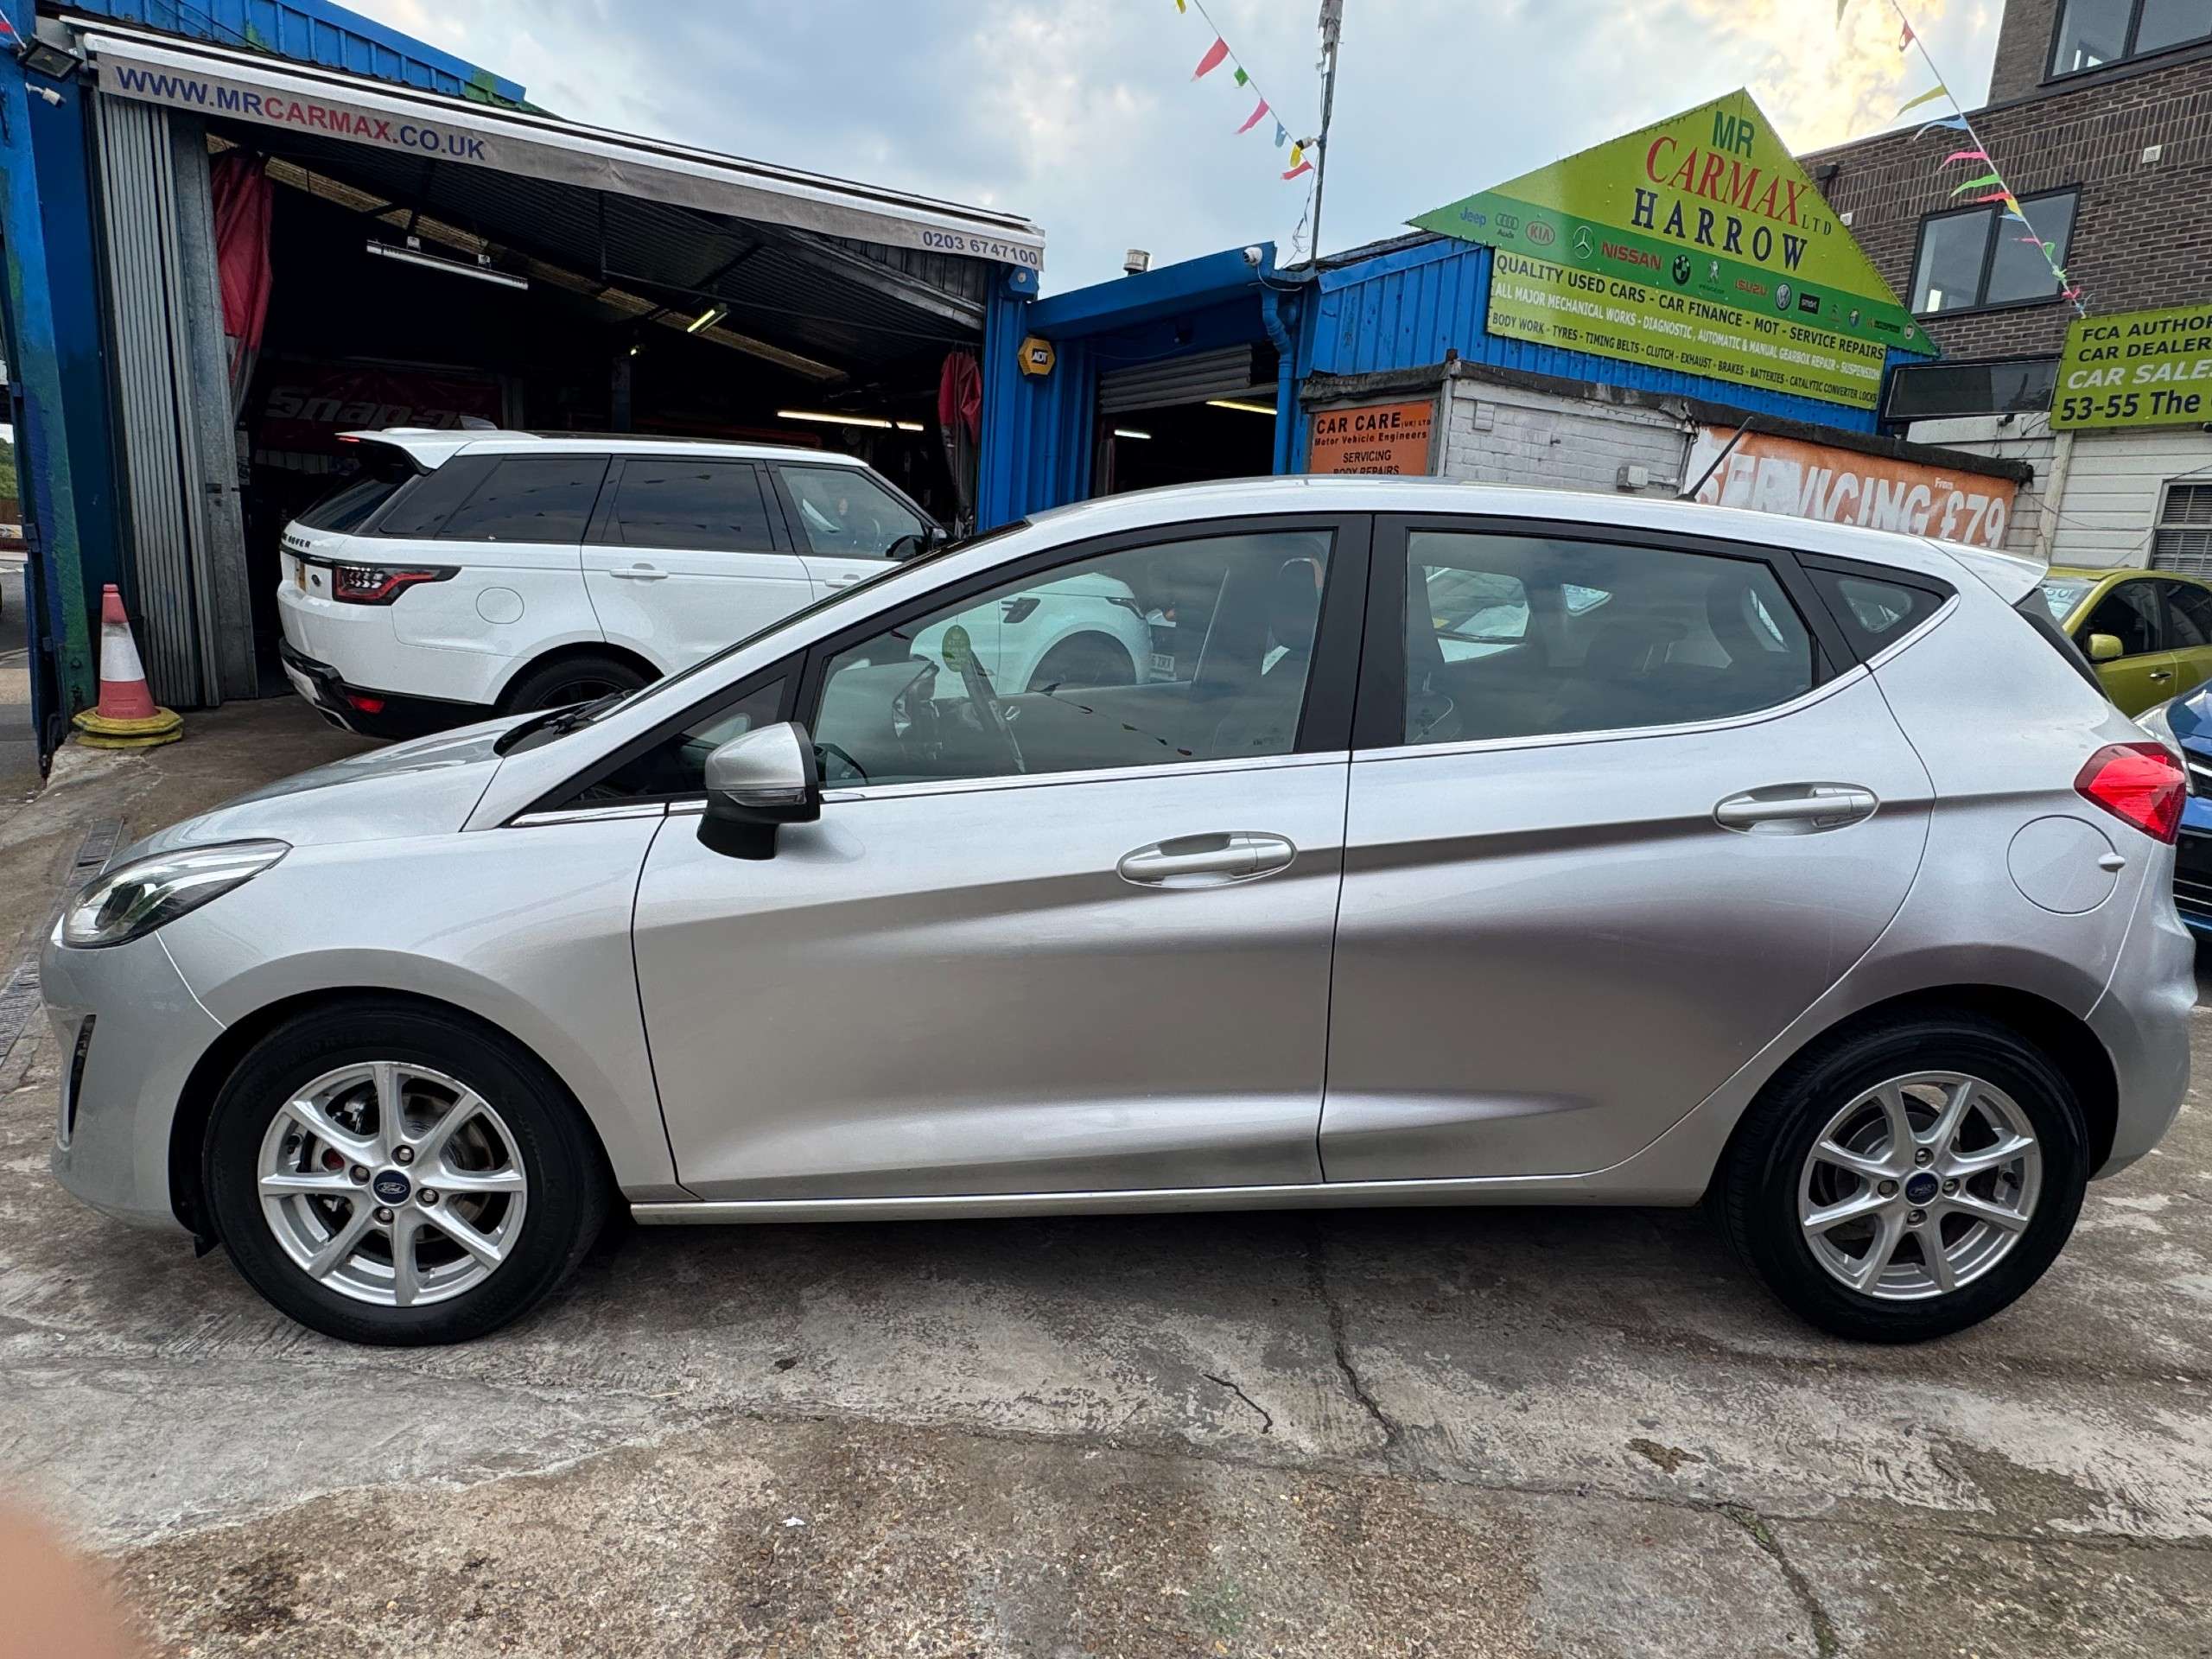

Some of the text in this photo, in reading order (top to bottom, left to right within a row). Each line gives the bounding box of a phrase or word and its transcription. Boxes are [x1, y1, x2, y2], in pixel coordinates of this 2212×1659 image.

[115, 66, 486, 162] WWW.MRCARMAX.CO.UK
[1712, 111, 1755, 159] MR
[1646, 136, 1808, 226] CARMAX
[1460, 207, 1486, 228] Jeep
[1529, 223, 1552, 242] KIA
[1631, 188, 1808, 271] HARROW
[1801, 213, 1832, 236] LTD
[923, 231, 1038, 265] 0203 6747100
[1602, 241, 1662, 271] NISSAN
[1497, 254, 1563, 283] QUALITY
[1567, 271, 1605, 294] USED
[1610, 282, 1646, 302] CARS
[1659, 295, 1684, 313] CAR
[1688, 301, 1743, 327] FINANCE
[1754, 317, 1780, 335] MOT
[1789, 327, 1836, 349] SERVICE
[1839, 338, 1884, 360] REPAIRS
[1496, 283, 1512, 299] ALL
[1515, 286, 1545, 306] MAJOR
[1548, 295, 1604, 320] MECHANICAL
[1606, 308, 1636, 326] WORKS
[1643, 315, 1692, 340] DIAGNOSTIC
[1698, 328, 1741, 350] AUTOMATIC
[1749, 340, 1777, 359] MANUAL
[1779, 348, 1811, 365] GEARBOX
[1811, 354, 1836, 371] REPAIR
[1840, 362, 1881, 381] SUSPENSION
[2082, 326, 2120, 342] FCA
[1032, 351, 1048, 364] ADT
[1493, 312, 1516, 327] BODY
[1519, 319, 1544, 334] WORK
[1553, 325, 1578, 340] TYRES
[1586, 331, 1615, 349] TIMING
[1617, 338, 1639, 353] BELTS
[1646, 345, 1674, 361] CLUTCH
[1681, 350, 1712, 369] EXHAUST
[1718, 359, 1744, 375] BRAKES
[1751, 367, 1784, 385] BATTERIES
[1789, 375, 1822, 393] CATALYTIC
[1823, 383, 1858, 399] CONVERTER
[1859, 391, 1878, 404] LOCKS
[2078, 336, 2212, 362] CAR DEALER
[2067, 359, 2212, 389] CAR SALE
[2060, 390, 2201, 422] 53-55 The
[1317, 416, 1347, 435] CAR
[1355, 411, 1401, 431] CARE
[1314, 431, 1427, 447] Motor Vehicle Engineers
[1343, 449, 1391, 464] SERVICING
